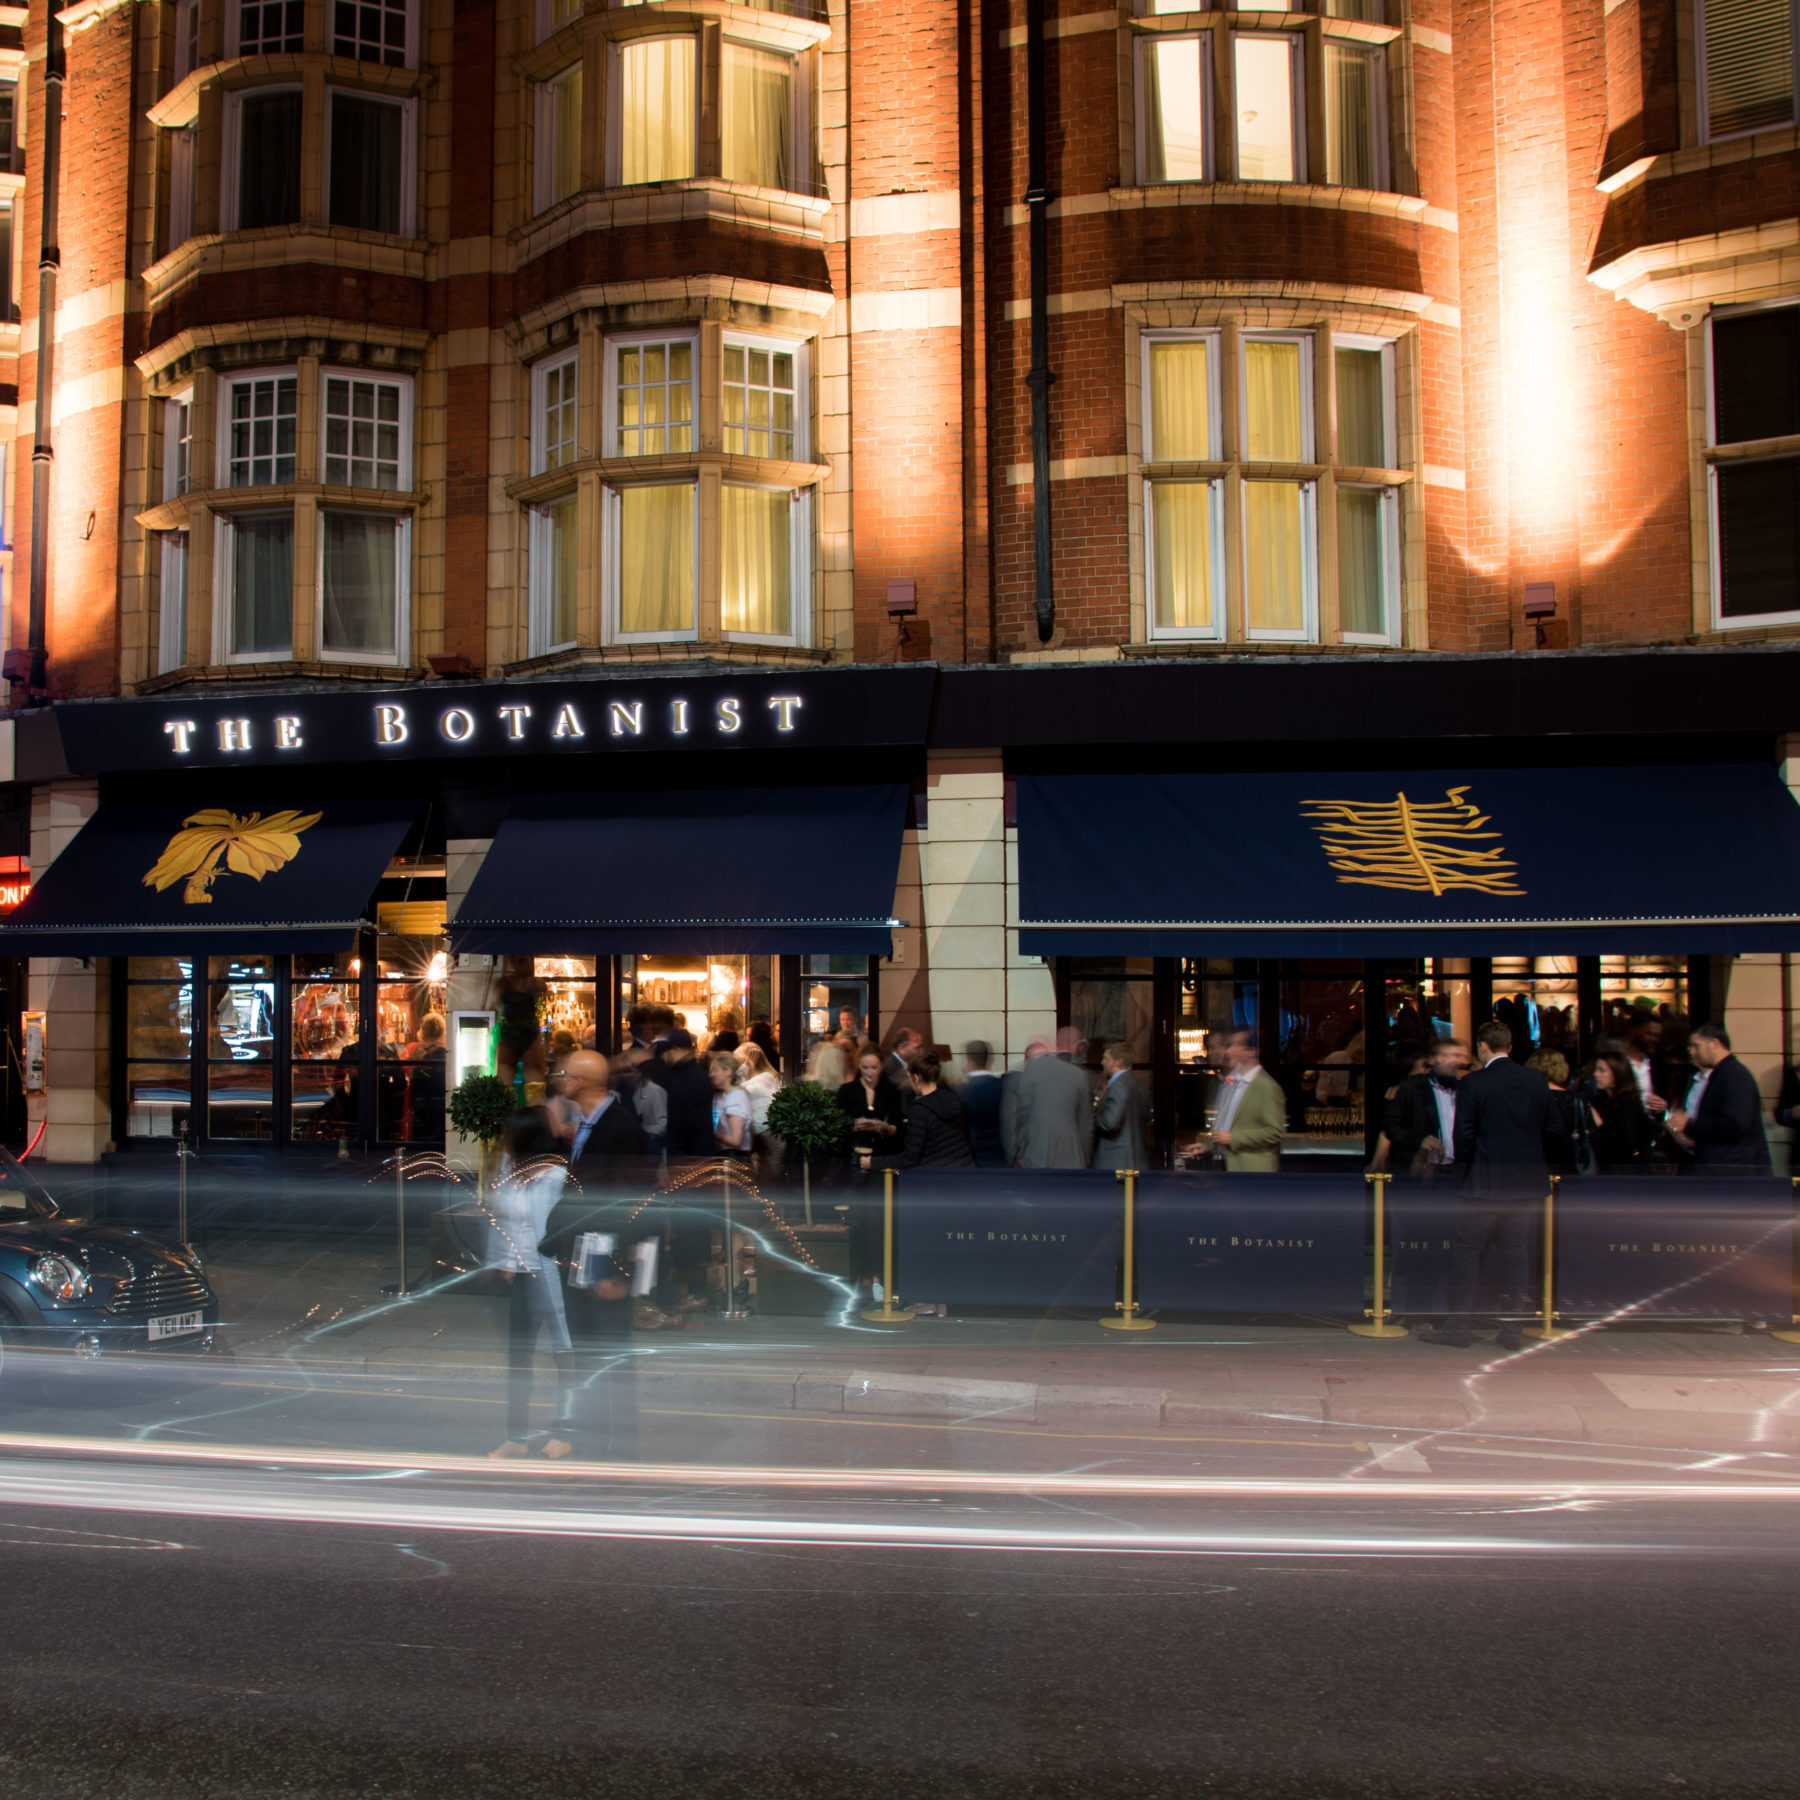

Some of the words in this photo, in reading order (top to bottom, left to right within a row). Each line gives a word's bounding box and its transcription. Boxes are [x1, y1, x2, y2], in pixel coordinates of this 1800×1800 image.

[163, 716, 303, 754] THE
[375, 695, 803, 745] BOTANIST
[946, 1232, 975, 1241] THE
[987, 1231, 1068, 1242] BOTANIST
[1187, 1236, 1218, 1246] THE
[1231, 1236, 1314, 1248] BOTANIST
[1399, 1241, 1428, 1249] THE
[1608, 1244, 1639, 1252] THE
[1652, 1243, 1738, 1253] BOTANIST
